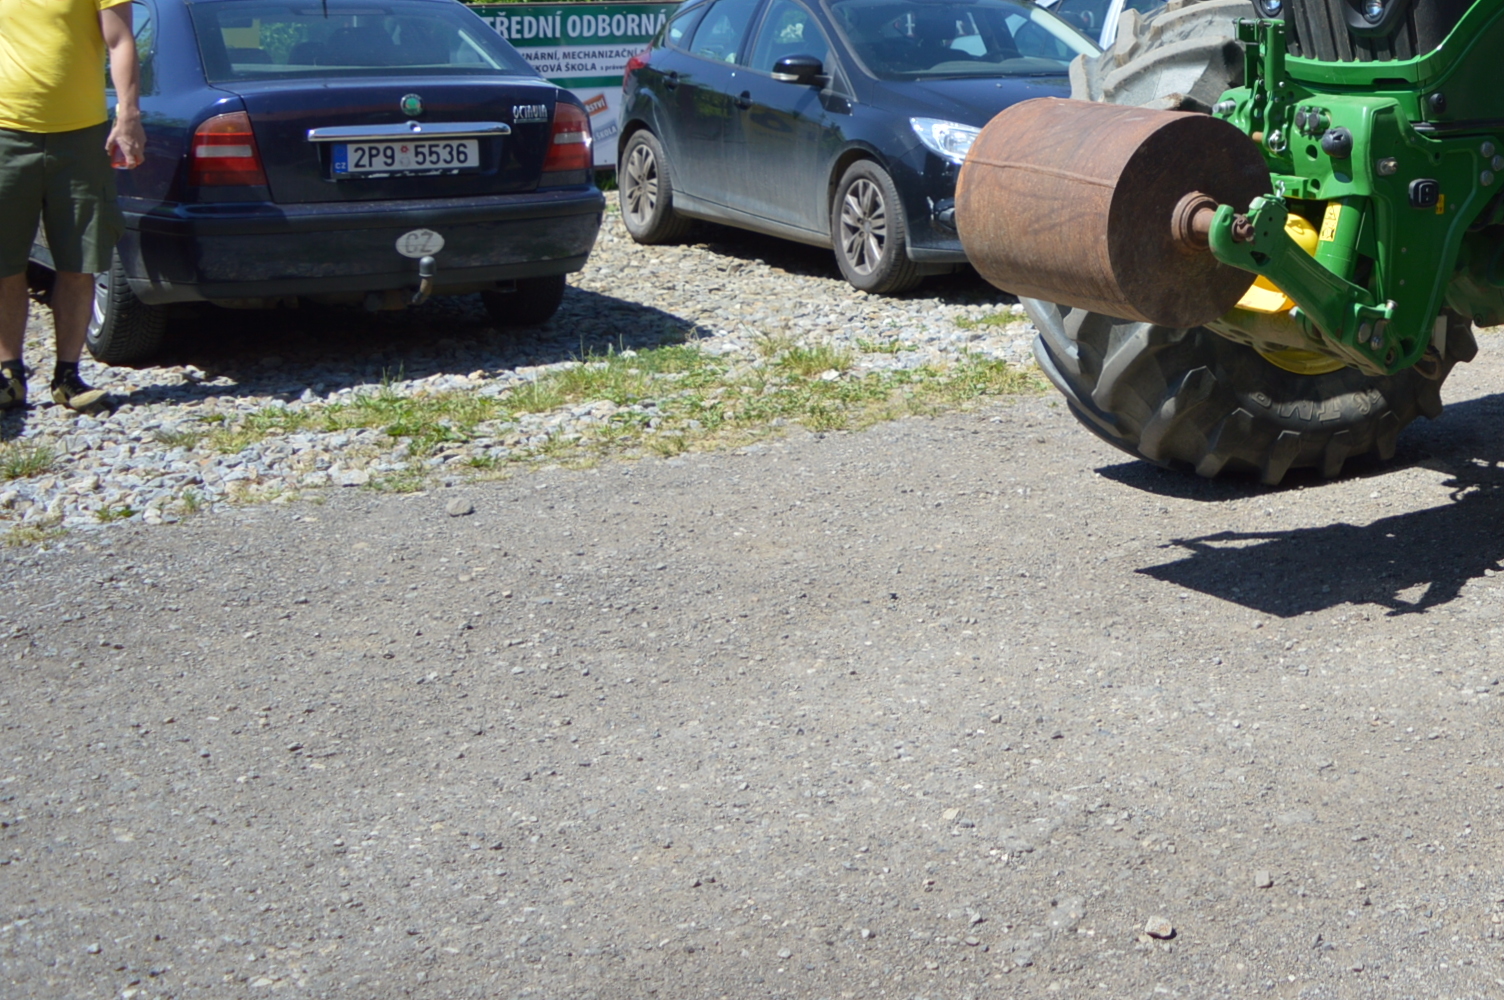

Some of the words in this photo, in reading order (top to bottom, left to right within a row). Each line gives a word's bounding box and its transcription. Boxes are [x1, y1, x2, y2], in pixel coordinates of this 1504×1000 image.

[566, 8, 667, 38] ODBORNÁ
[564, 60, 597, 72] ŠKOLA
[512, 104, 548, 119] OCTAVIA
[334, 161, 347, 170] CZ
[353, 145, 396, 169] 2P9
[414, 142, 469, 166] 5536
[404, 230, 435, 254] CZ
